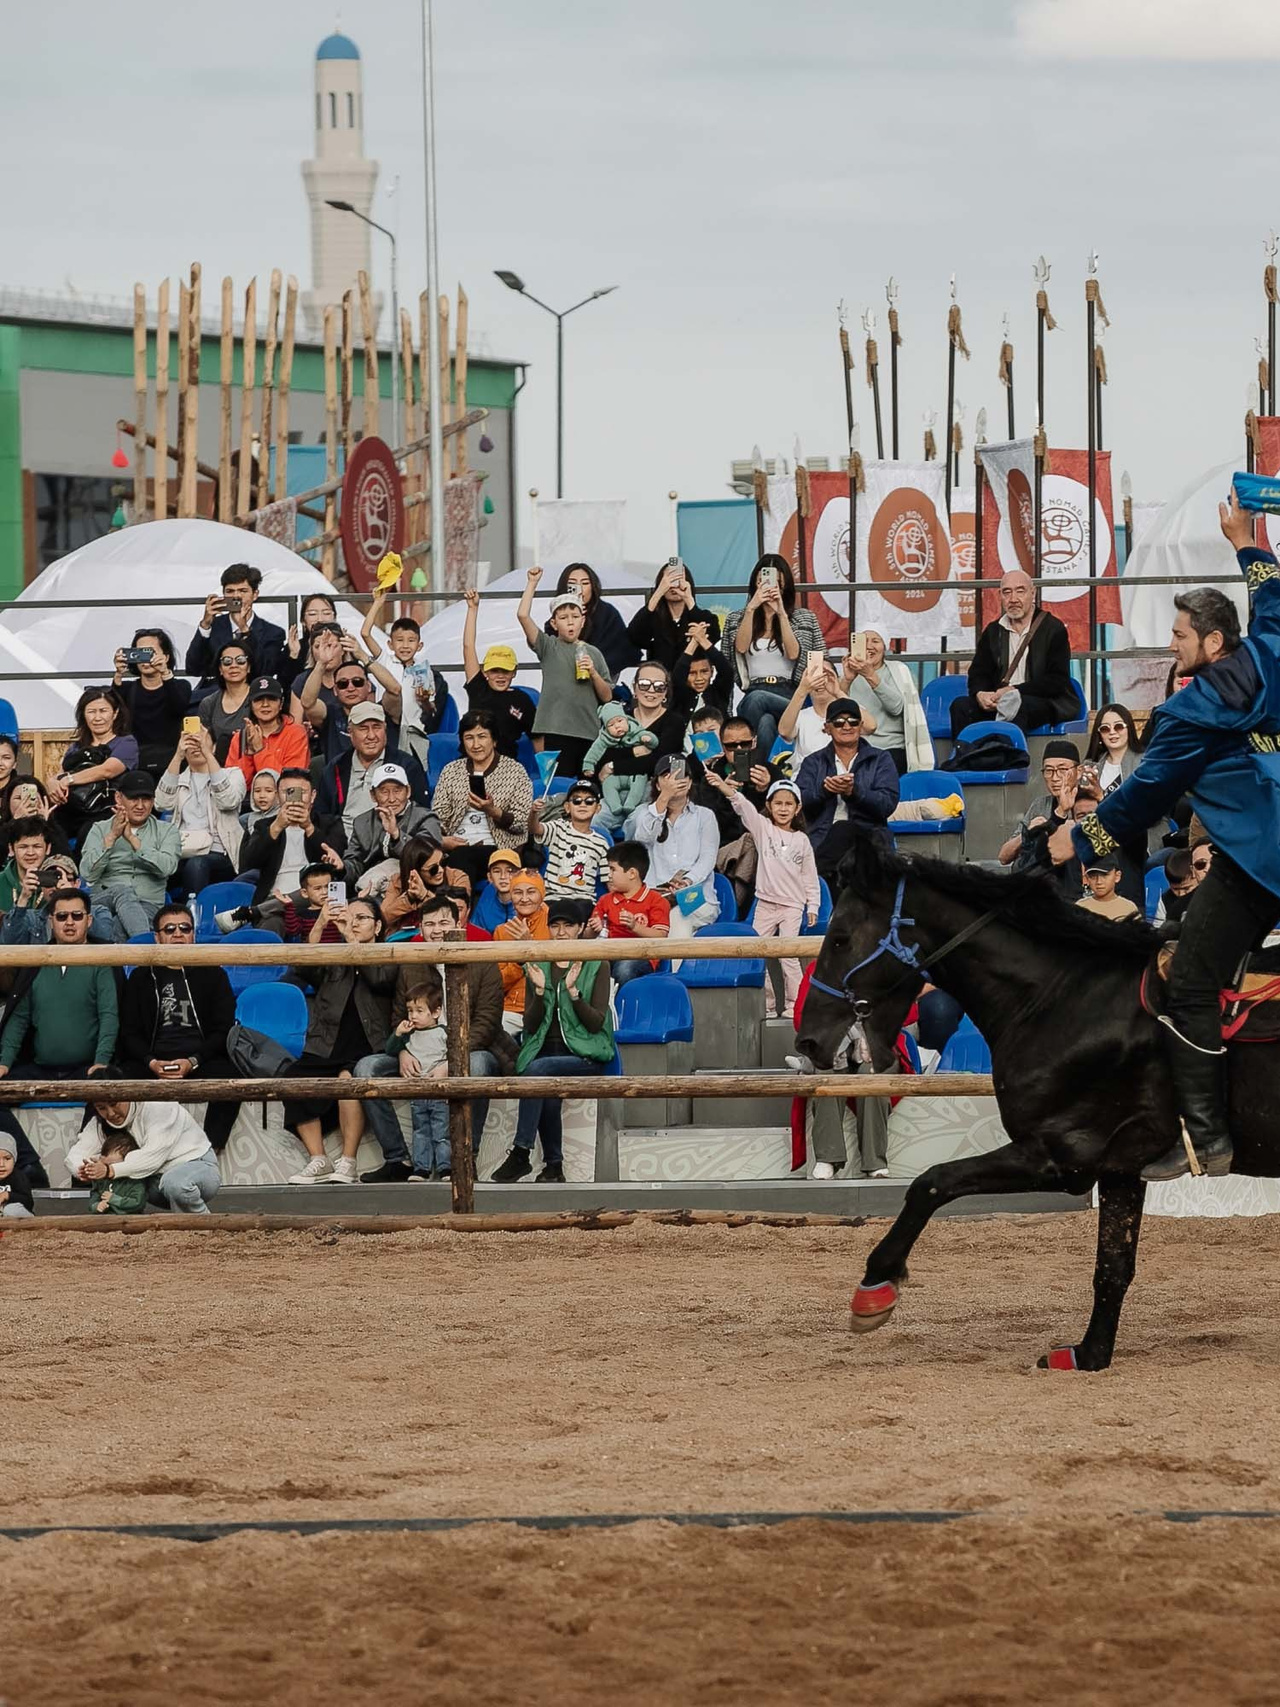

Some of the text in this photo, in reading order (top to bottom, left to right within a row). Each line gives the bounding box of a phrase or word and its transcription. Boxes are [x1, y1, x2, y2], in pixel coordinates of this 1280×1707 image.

[1049, 499, 1083, 516] NOMAD
[886, 514, 904, 548] WORLD
[906, 590, 925, 598] 2024
